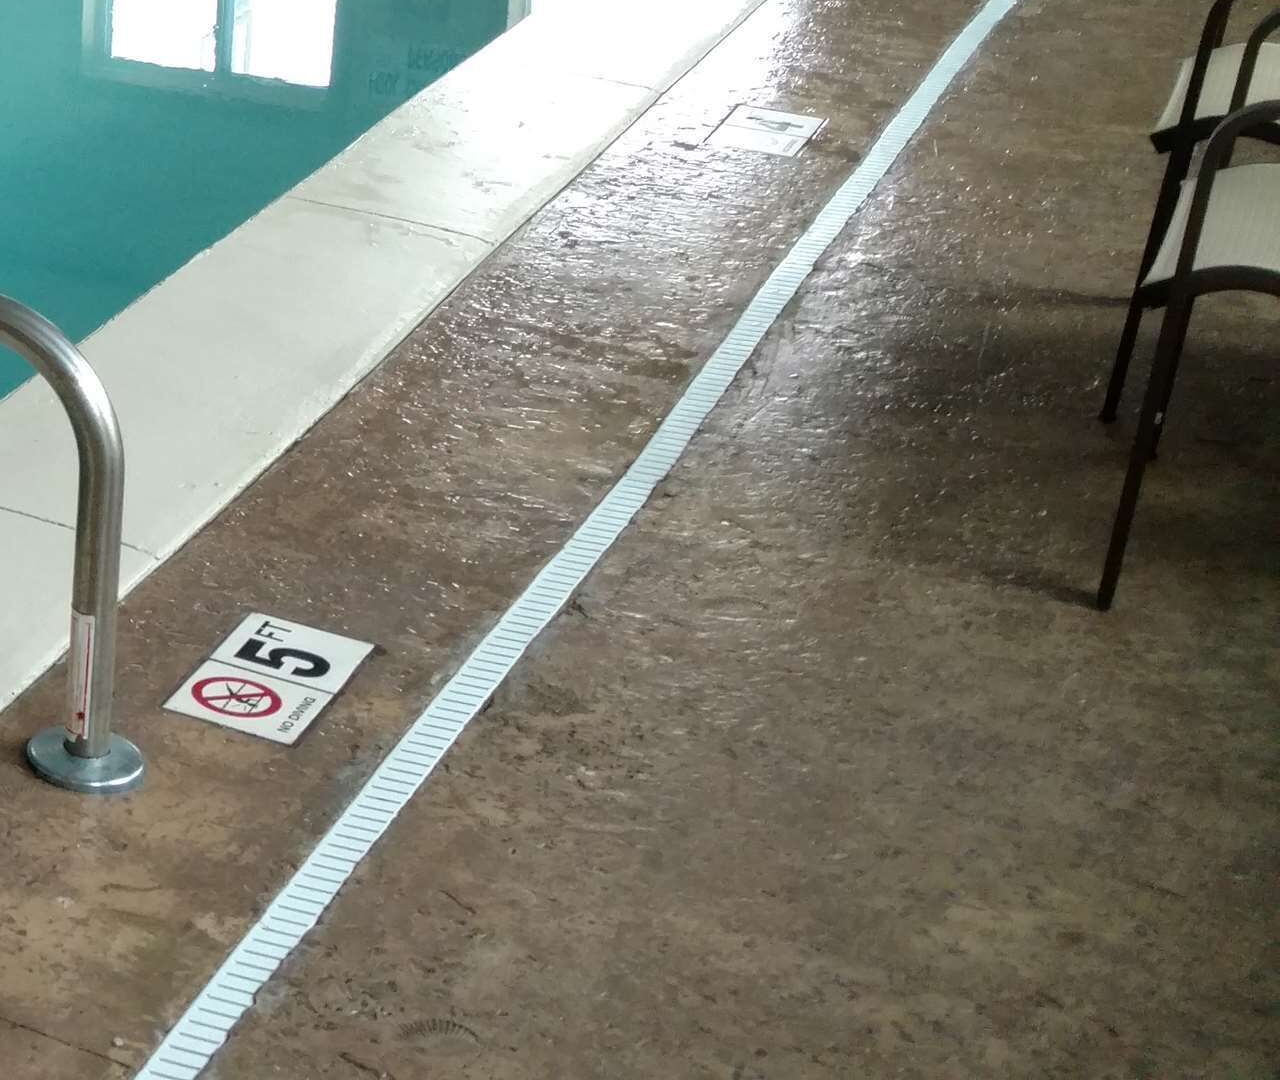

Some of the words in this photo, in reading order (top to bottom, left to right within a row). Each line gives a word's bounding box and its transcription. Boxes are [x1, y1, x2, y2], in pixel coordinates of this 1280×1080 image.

[255, 620, 292, 642] FT
[234, 638, 331, 678] 5
[277, 720, 295, 734] NO
[290, 696, 316, 723] DIVING
